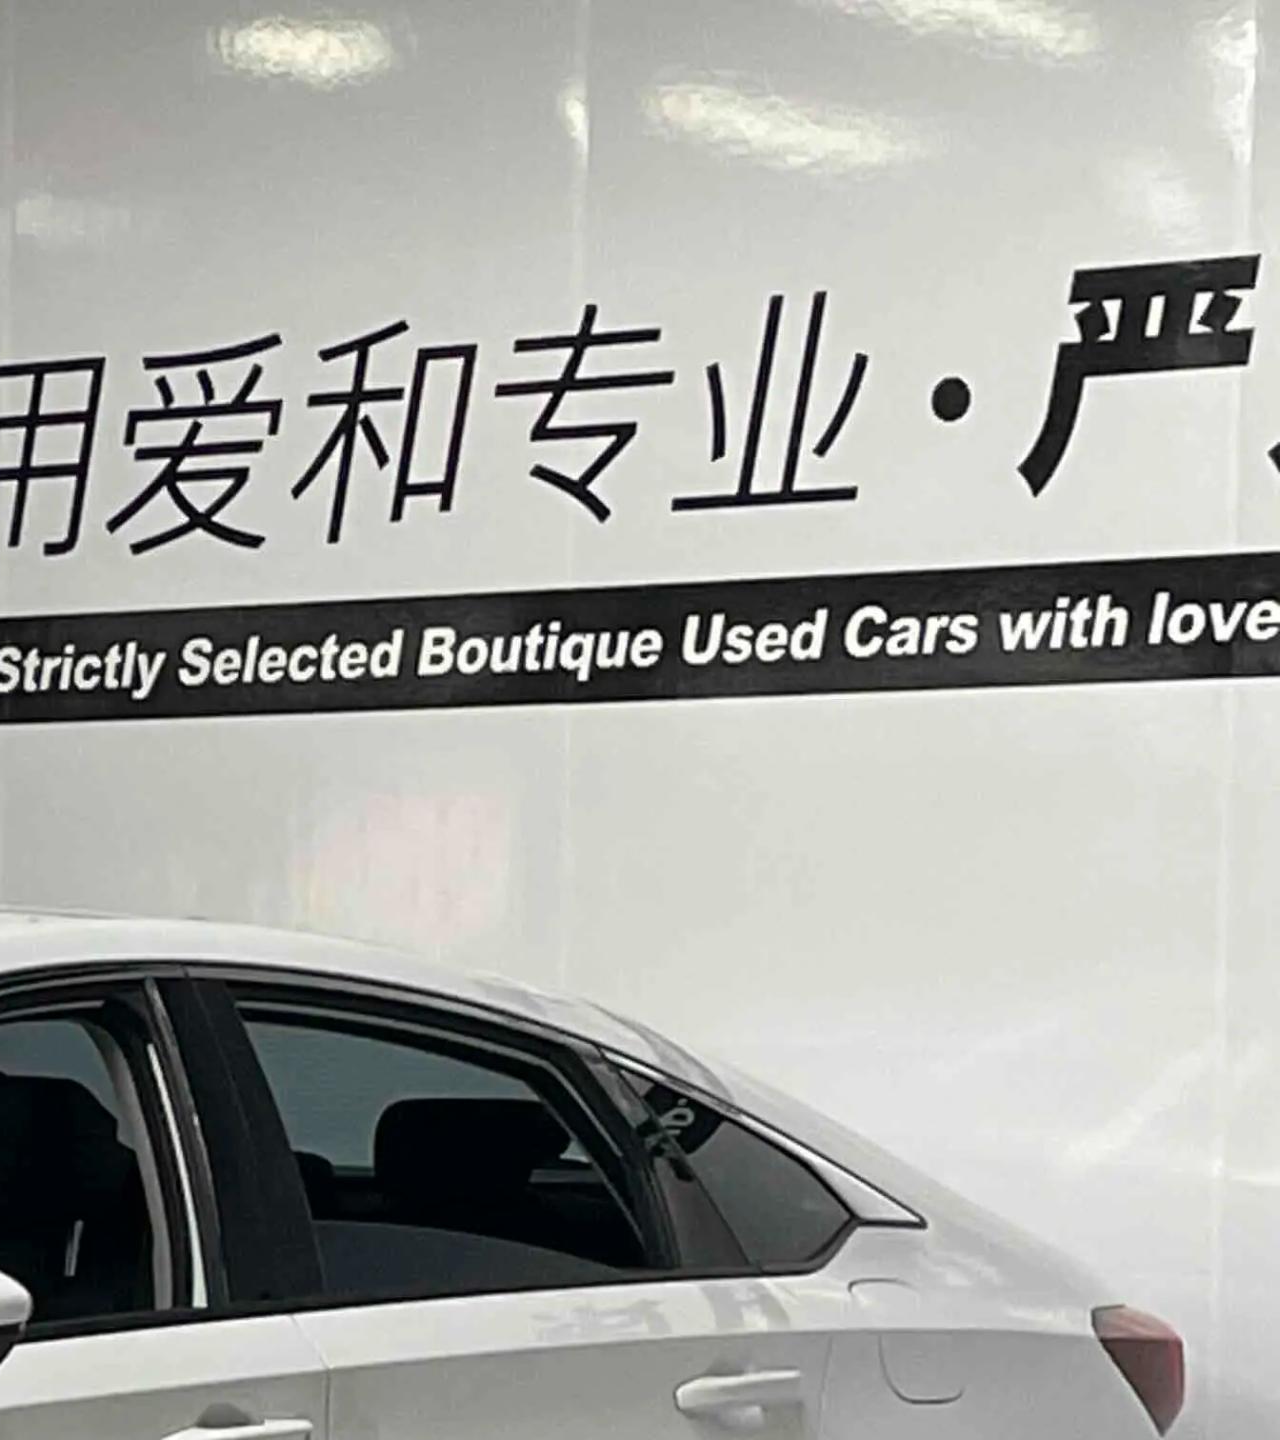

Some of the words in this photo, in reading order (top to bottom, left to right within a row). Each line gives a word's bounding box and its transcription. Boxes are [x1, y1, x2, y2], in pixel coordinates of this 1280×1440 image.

[178, 628, 404, 686] Selected
[417, 621, 663, 682] Boutique
[682, 608, 829, 665] Used
[844, 605, 979, 658] Cars
[999, 594, 1129, 652] with
[1148, 591, 1280, 645] love
